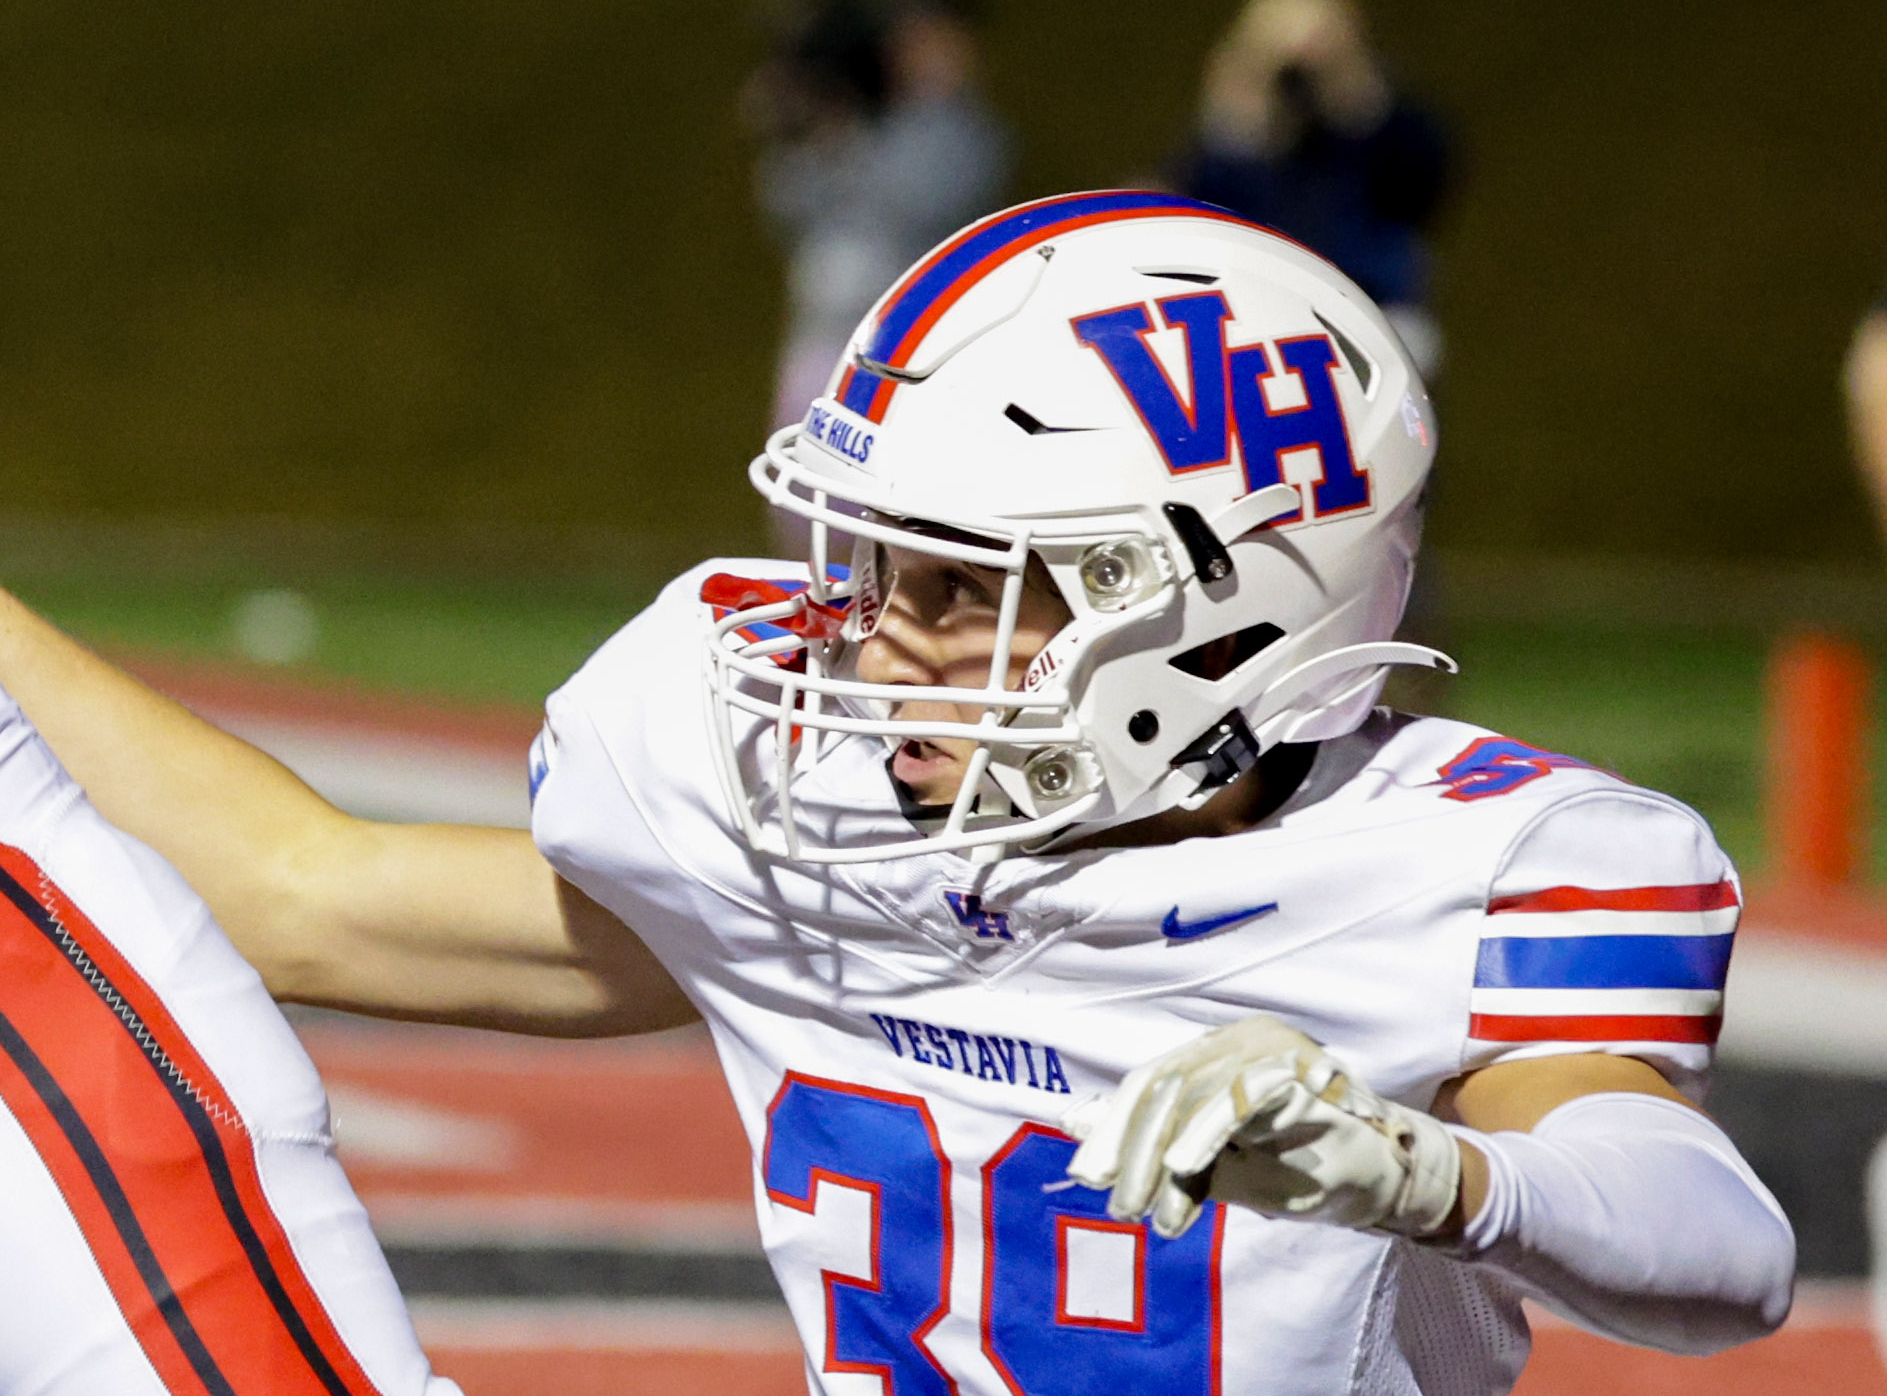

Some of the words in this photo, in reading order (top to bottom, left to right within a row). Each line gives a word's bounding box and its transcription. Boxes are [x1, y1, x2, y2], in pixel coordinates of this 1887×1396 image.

[826, 418, 874, 463] HILLS
[1069, 290, 1372, 530] VH
[943, 889, 1016, 942] VH
[869, 1013, 1071, 1094] VESTAVIA
